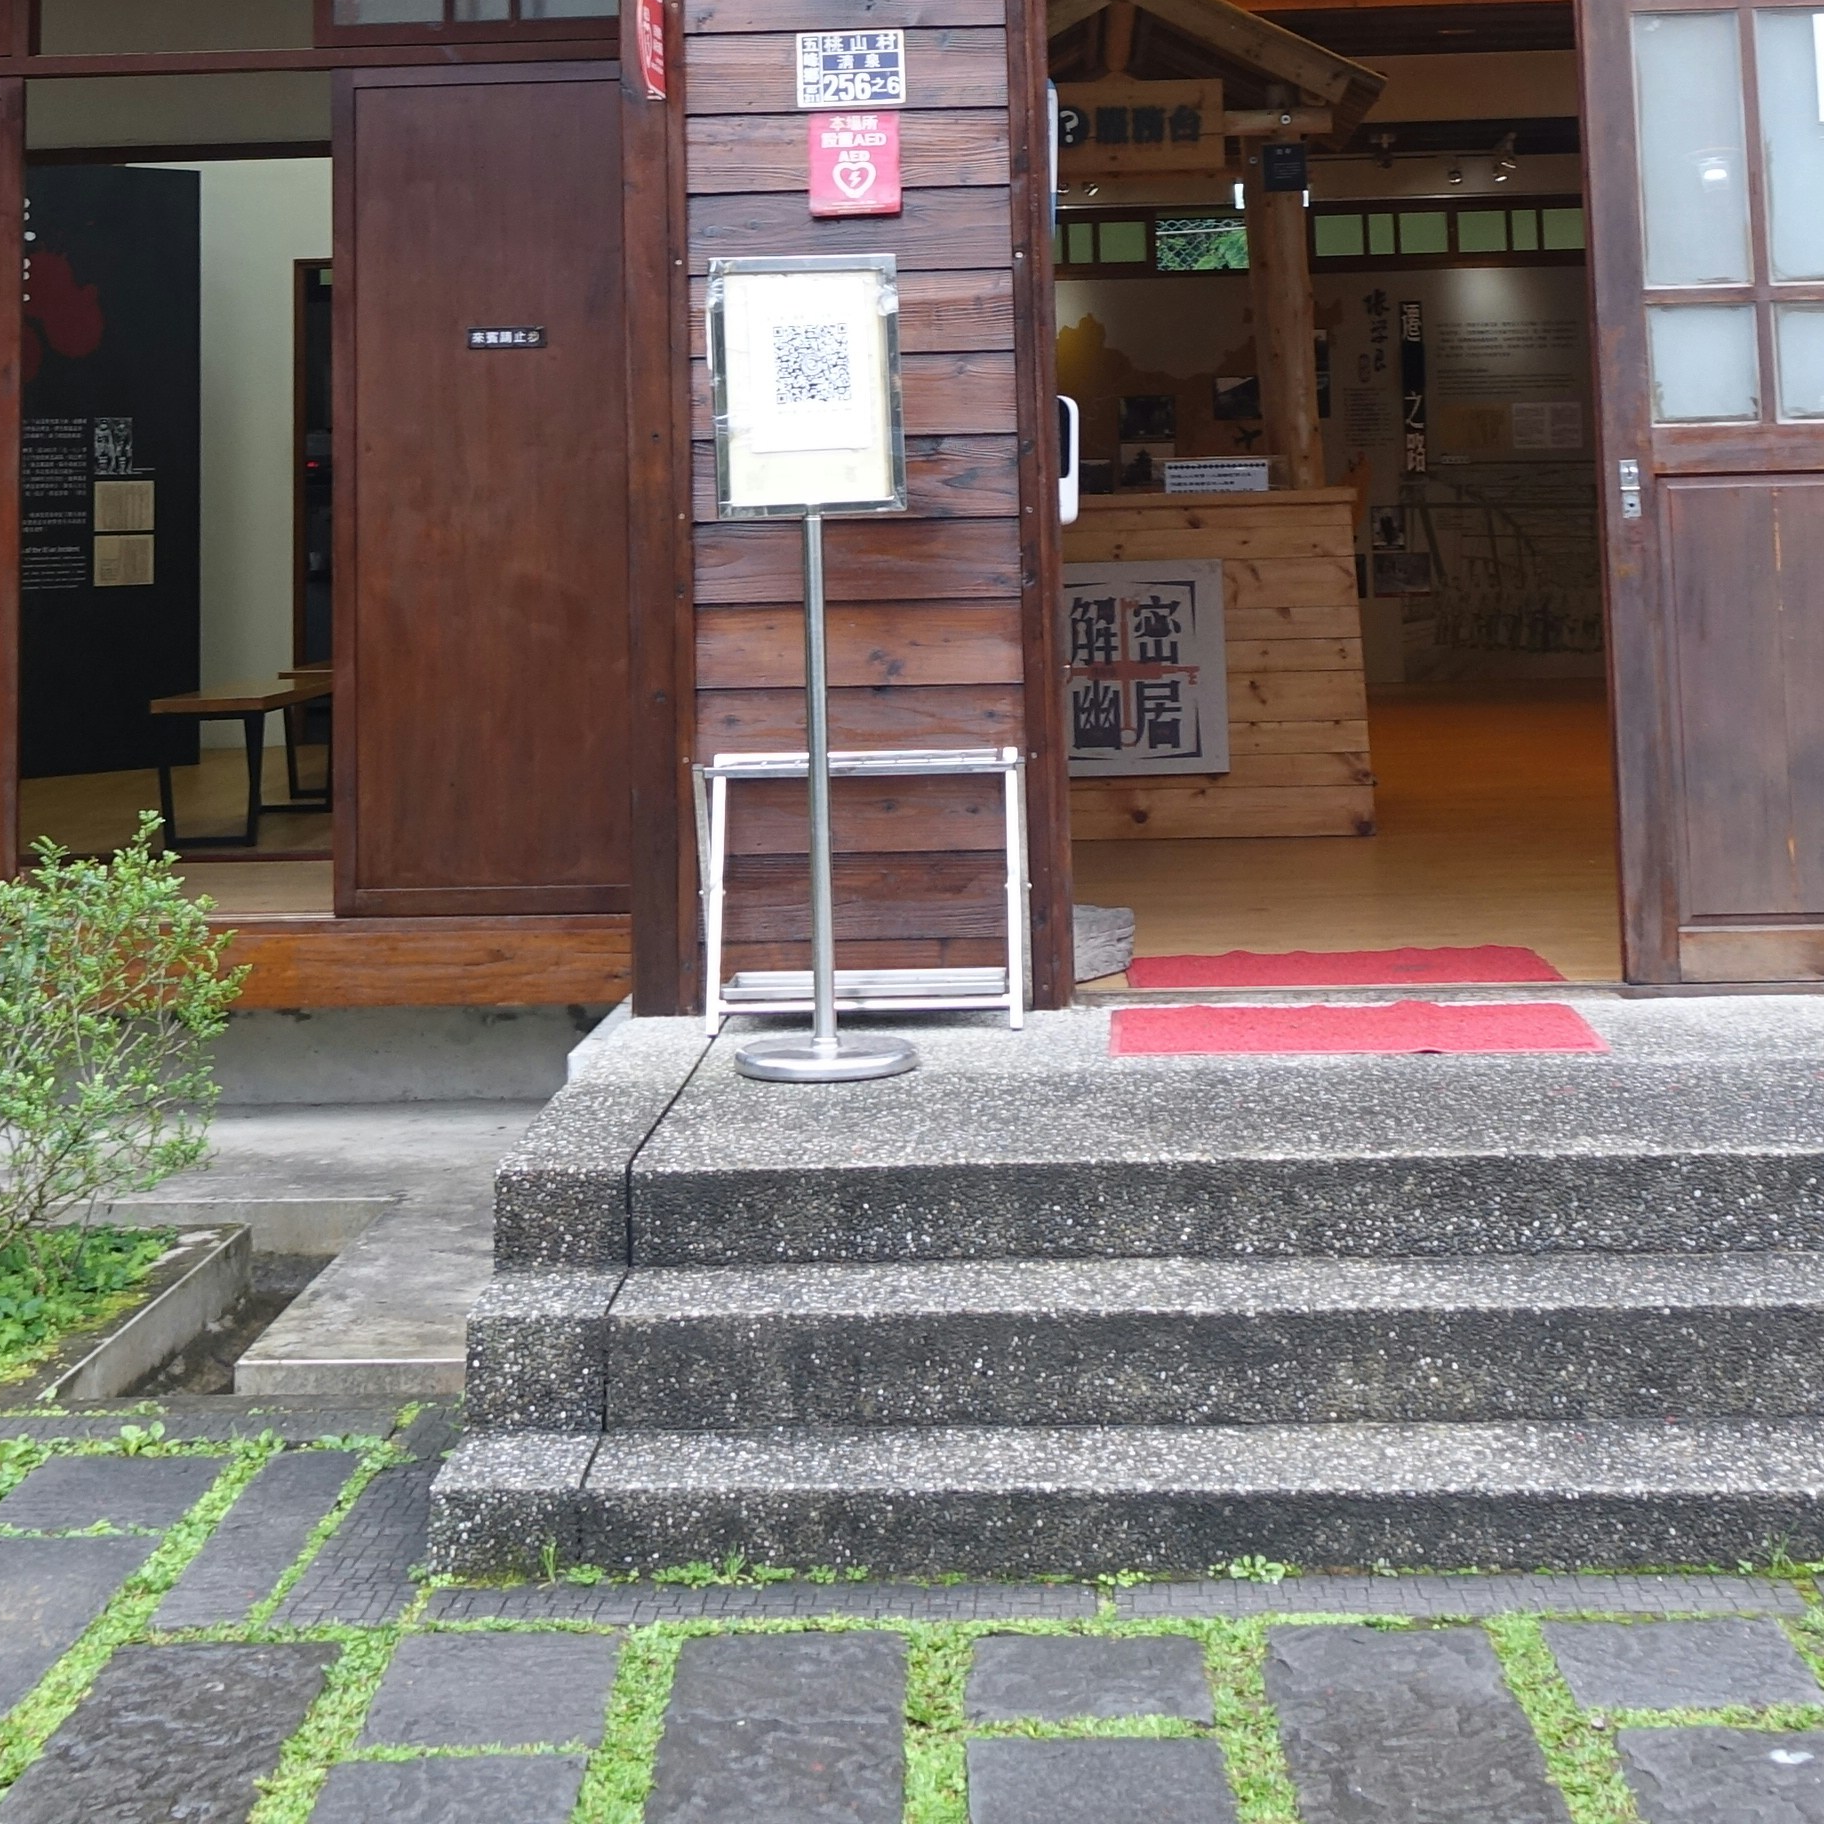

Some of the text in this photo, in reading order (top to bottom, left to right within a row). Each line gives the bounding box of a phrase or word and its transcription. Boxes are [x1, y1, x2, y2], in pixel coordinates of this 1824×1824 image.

[823, 34, 897, 52] 桃山村
[837, 53, 881, 69] 清泉
[823, 72, 901, 102] 256之6
[829, 115, 879, 131] 本場所
[838, 150, 871, 162] AED
[471, 330, 540, 344] 來賓請止步
[1069, 594, 1182, 665] 解密
[1072, 679, 1182, 750] 幽居
